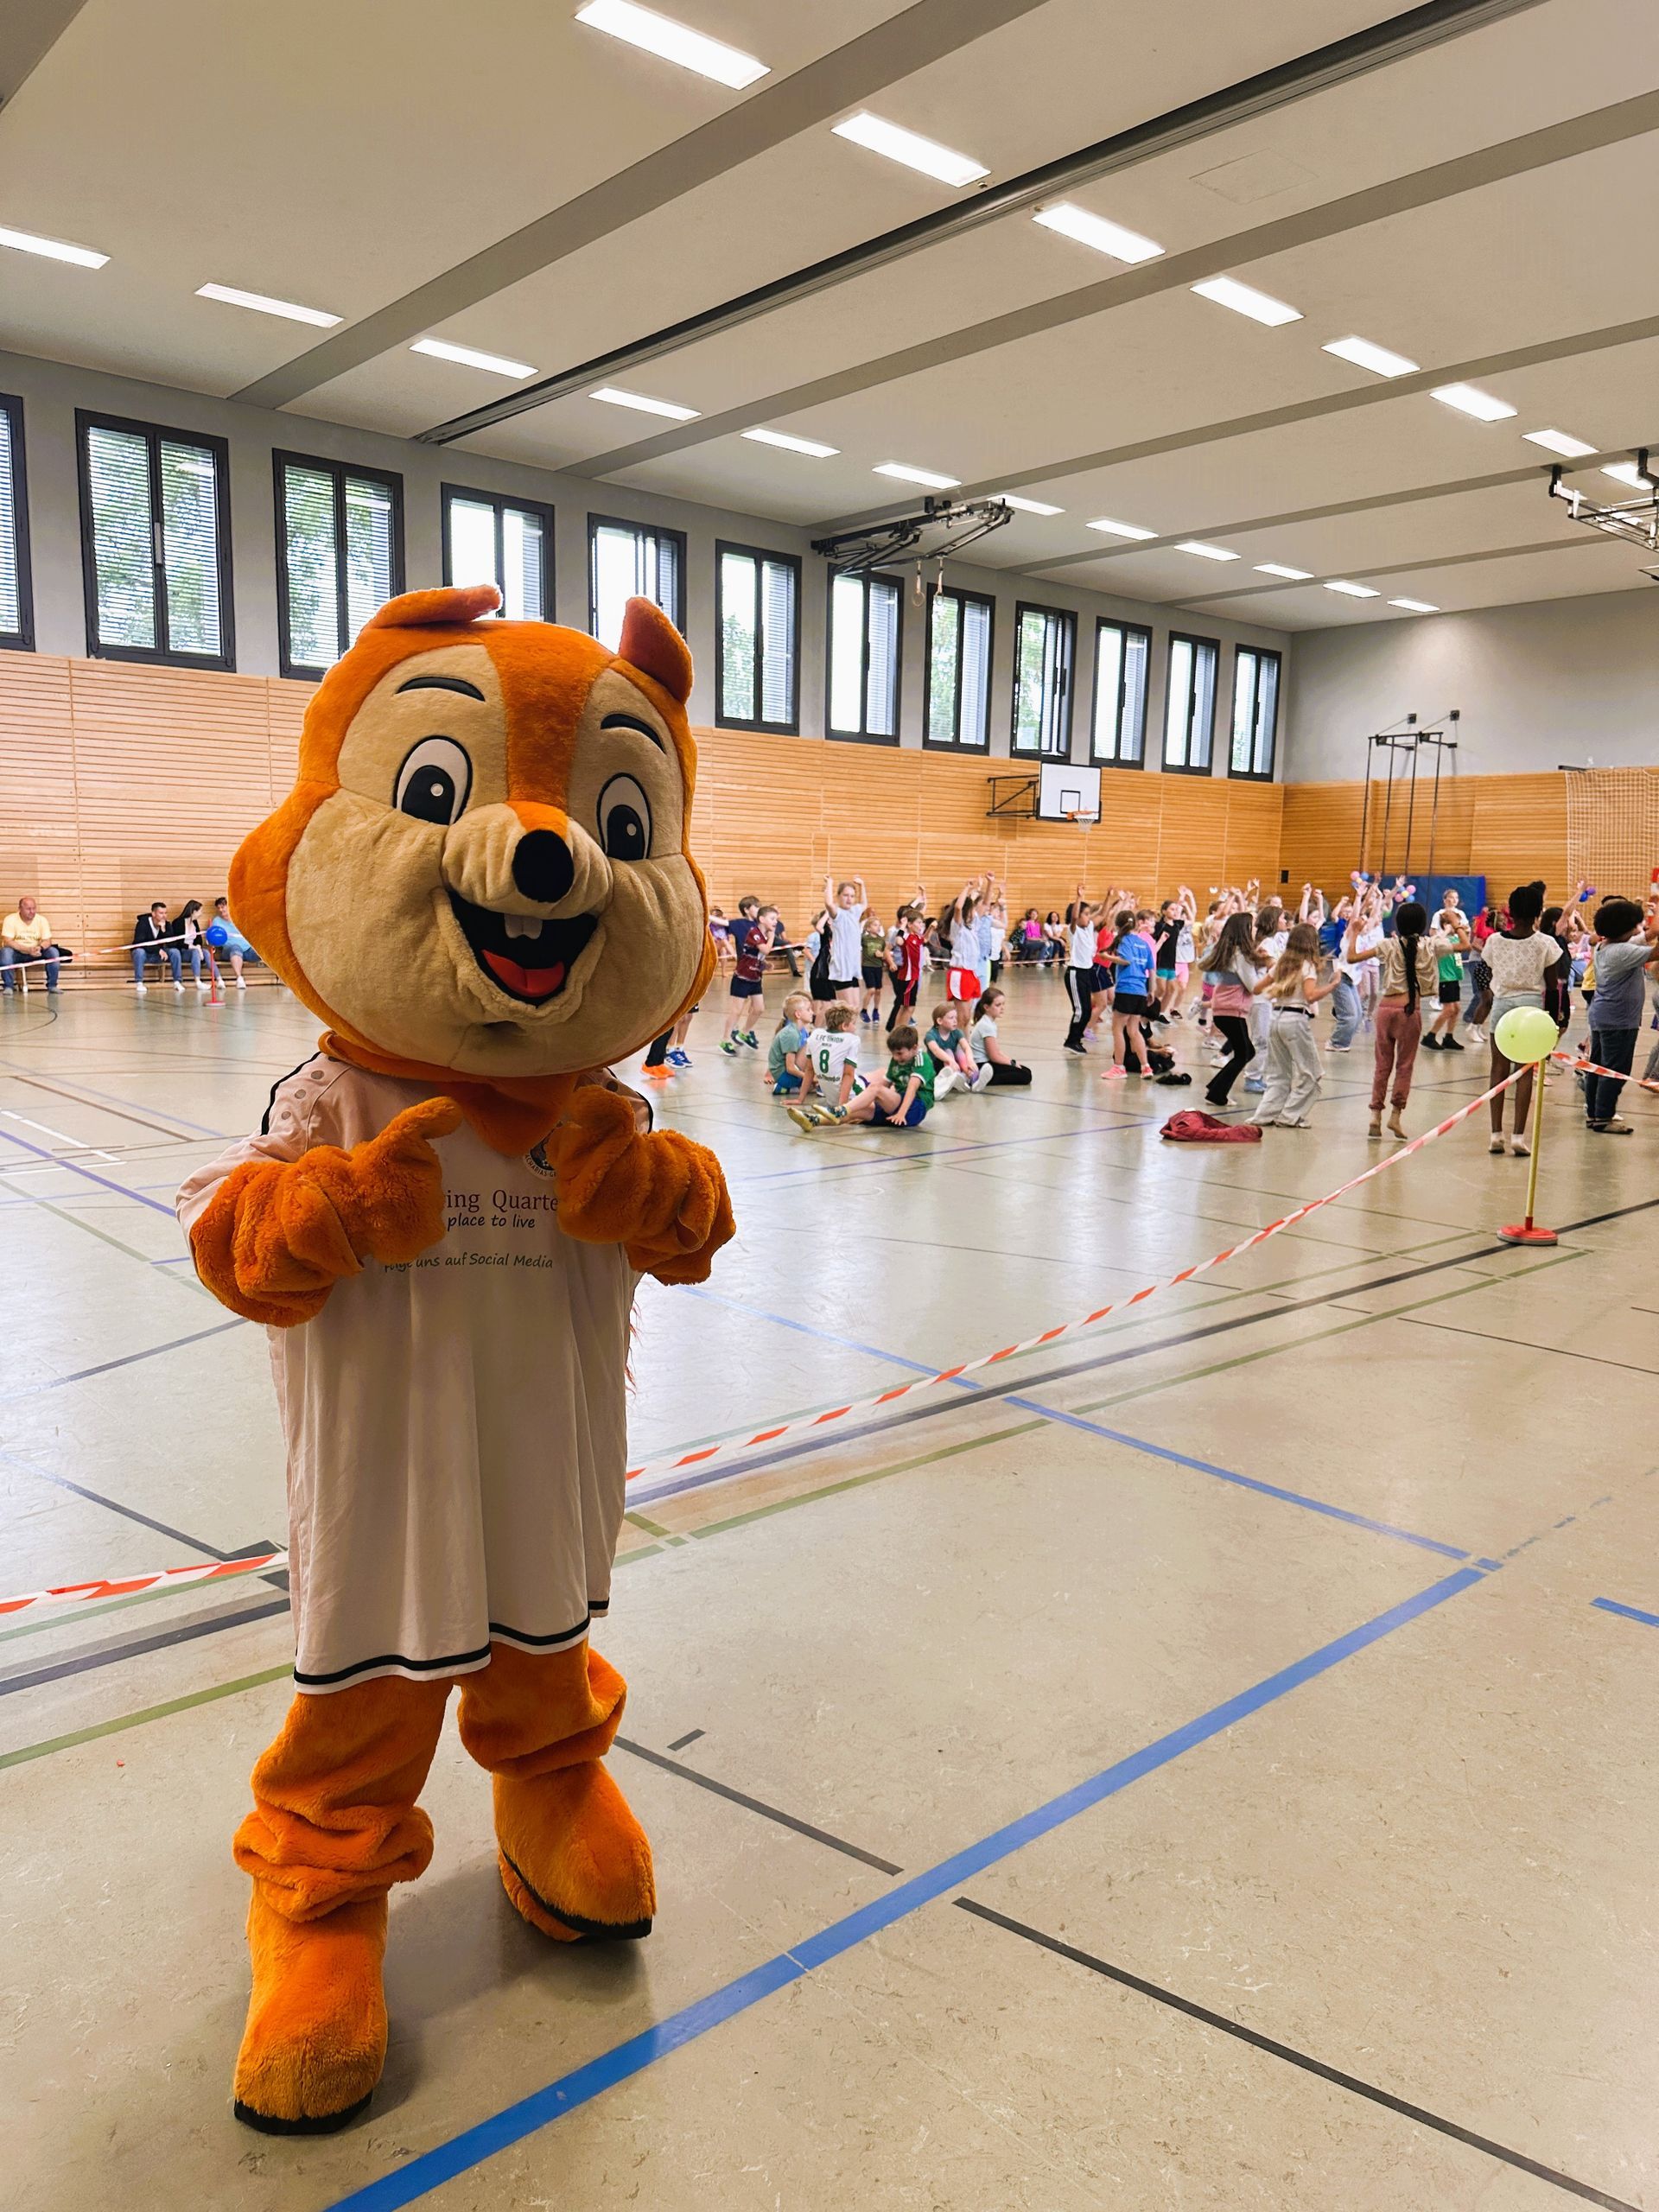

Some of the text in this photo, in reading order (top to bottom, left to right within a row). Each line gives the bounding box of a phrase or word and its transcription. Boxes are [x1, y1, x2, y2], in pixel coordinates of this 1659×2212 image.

[819, 1049, 830, 1074] 8
[447, 1189, 559, 1213] ing Quarte
[448, 1212, 536, 1232] place to live
[416, 1255, 441, 1268] uns
[445, 1251, 467, 1266] auf
[469, 1252, 509, 1266] Social
[513, 1255, 554, 1268] Media
